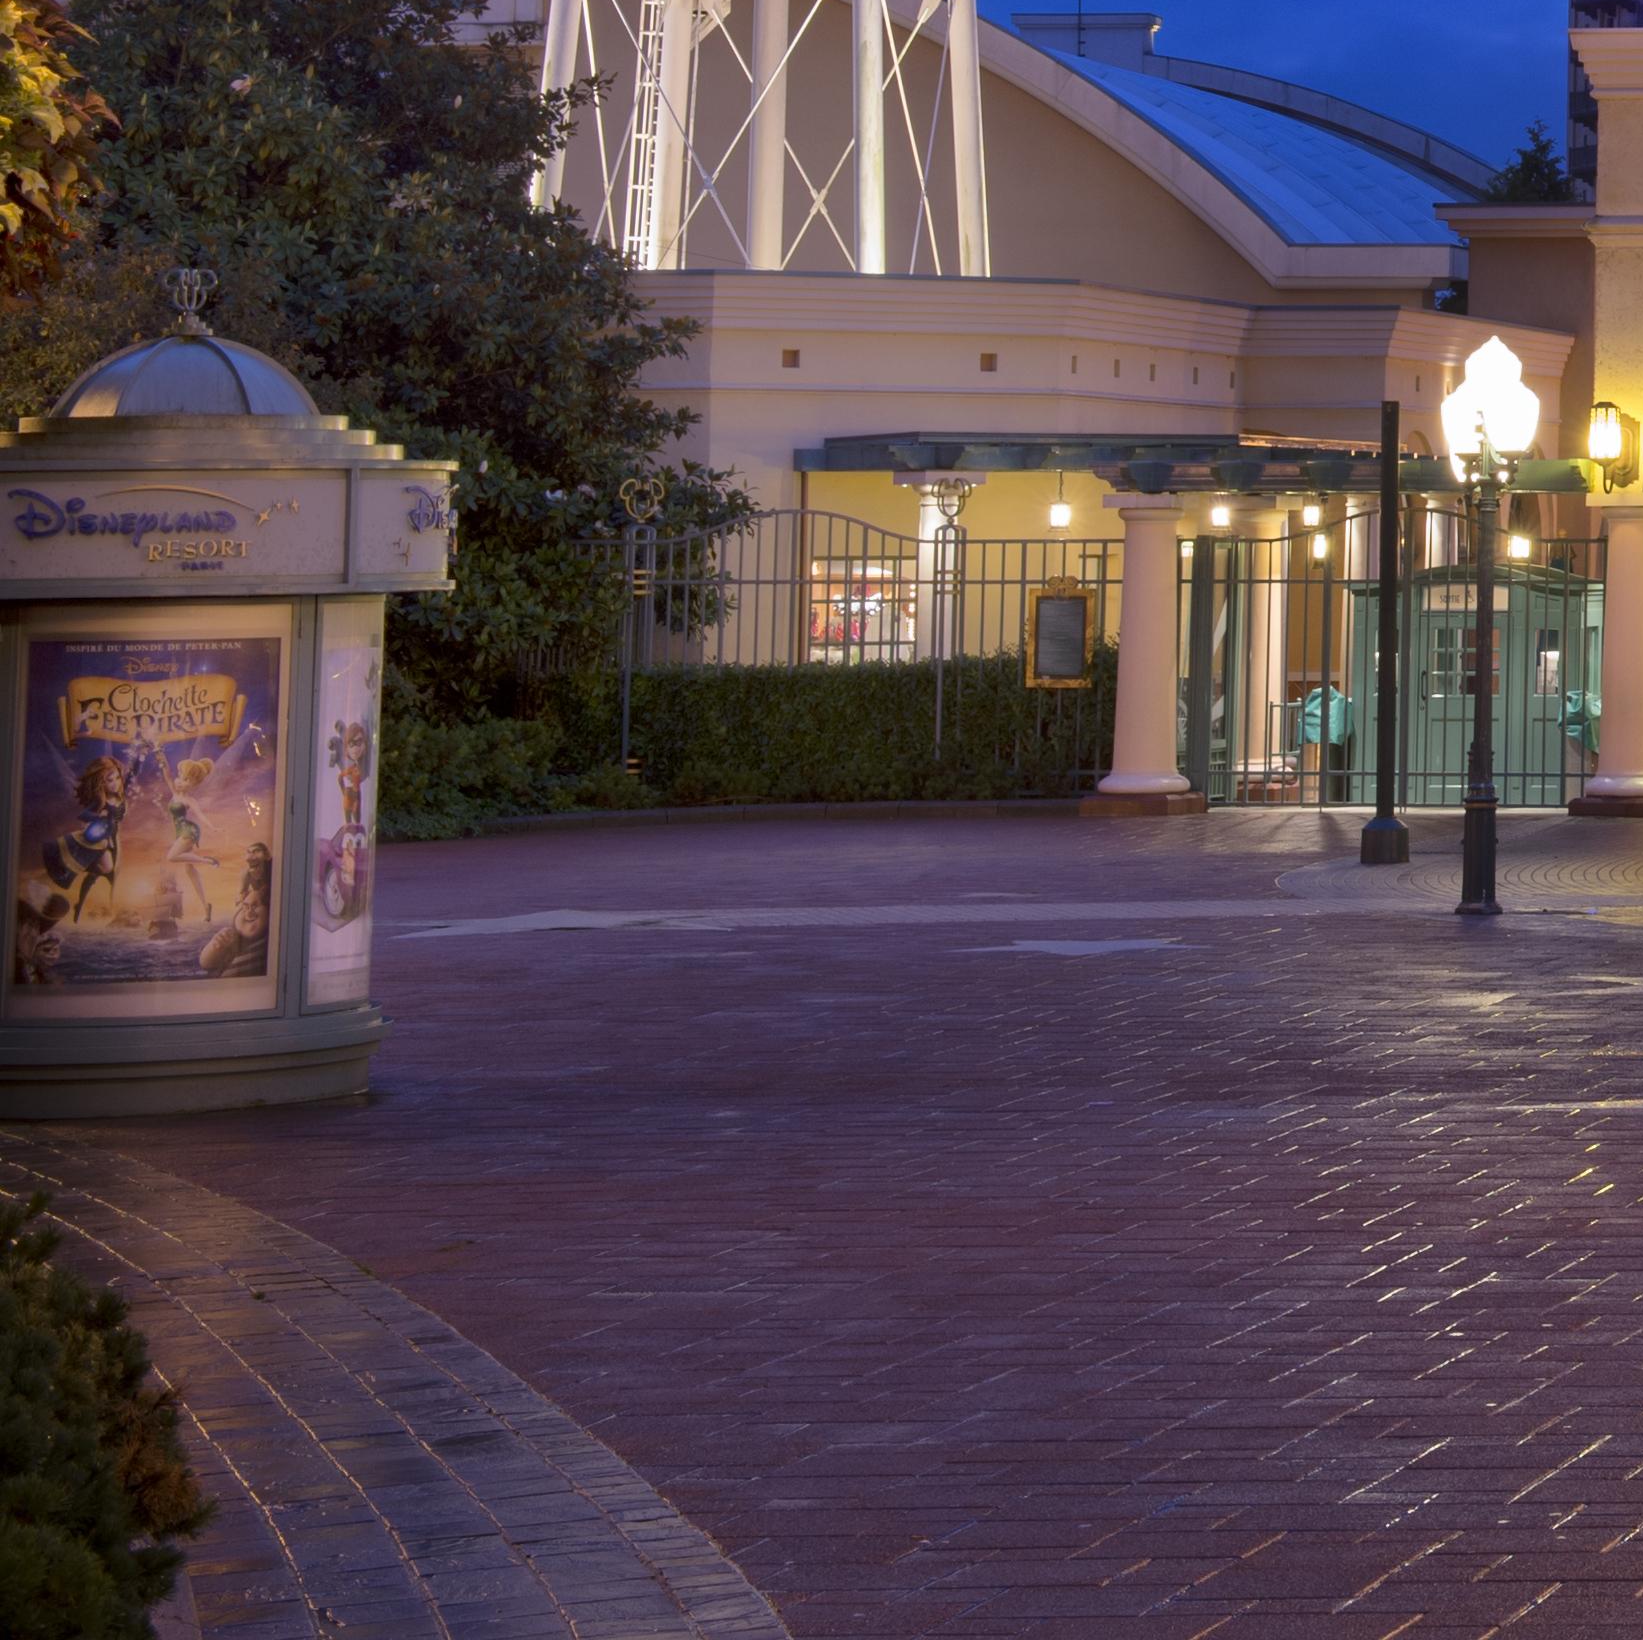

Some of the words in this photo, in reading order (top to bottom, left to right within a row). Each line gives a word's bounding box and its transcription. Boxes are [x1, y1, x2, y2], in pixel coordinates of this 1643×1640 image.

[148, 539, 251, 561] RESORT
[107, 644, 121, 652] DU
[124, 643, 164, 652] MONDE
[168, 643, 182, 651] DE
[108, 683, 208, 713] Clochette
